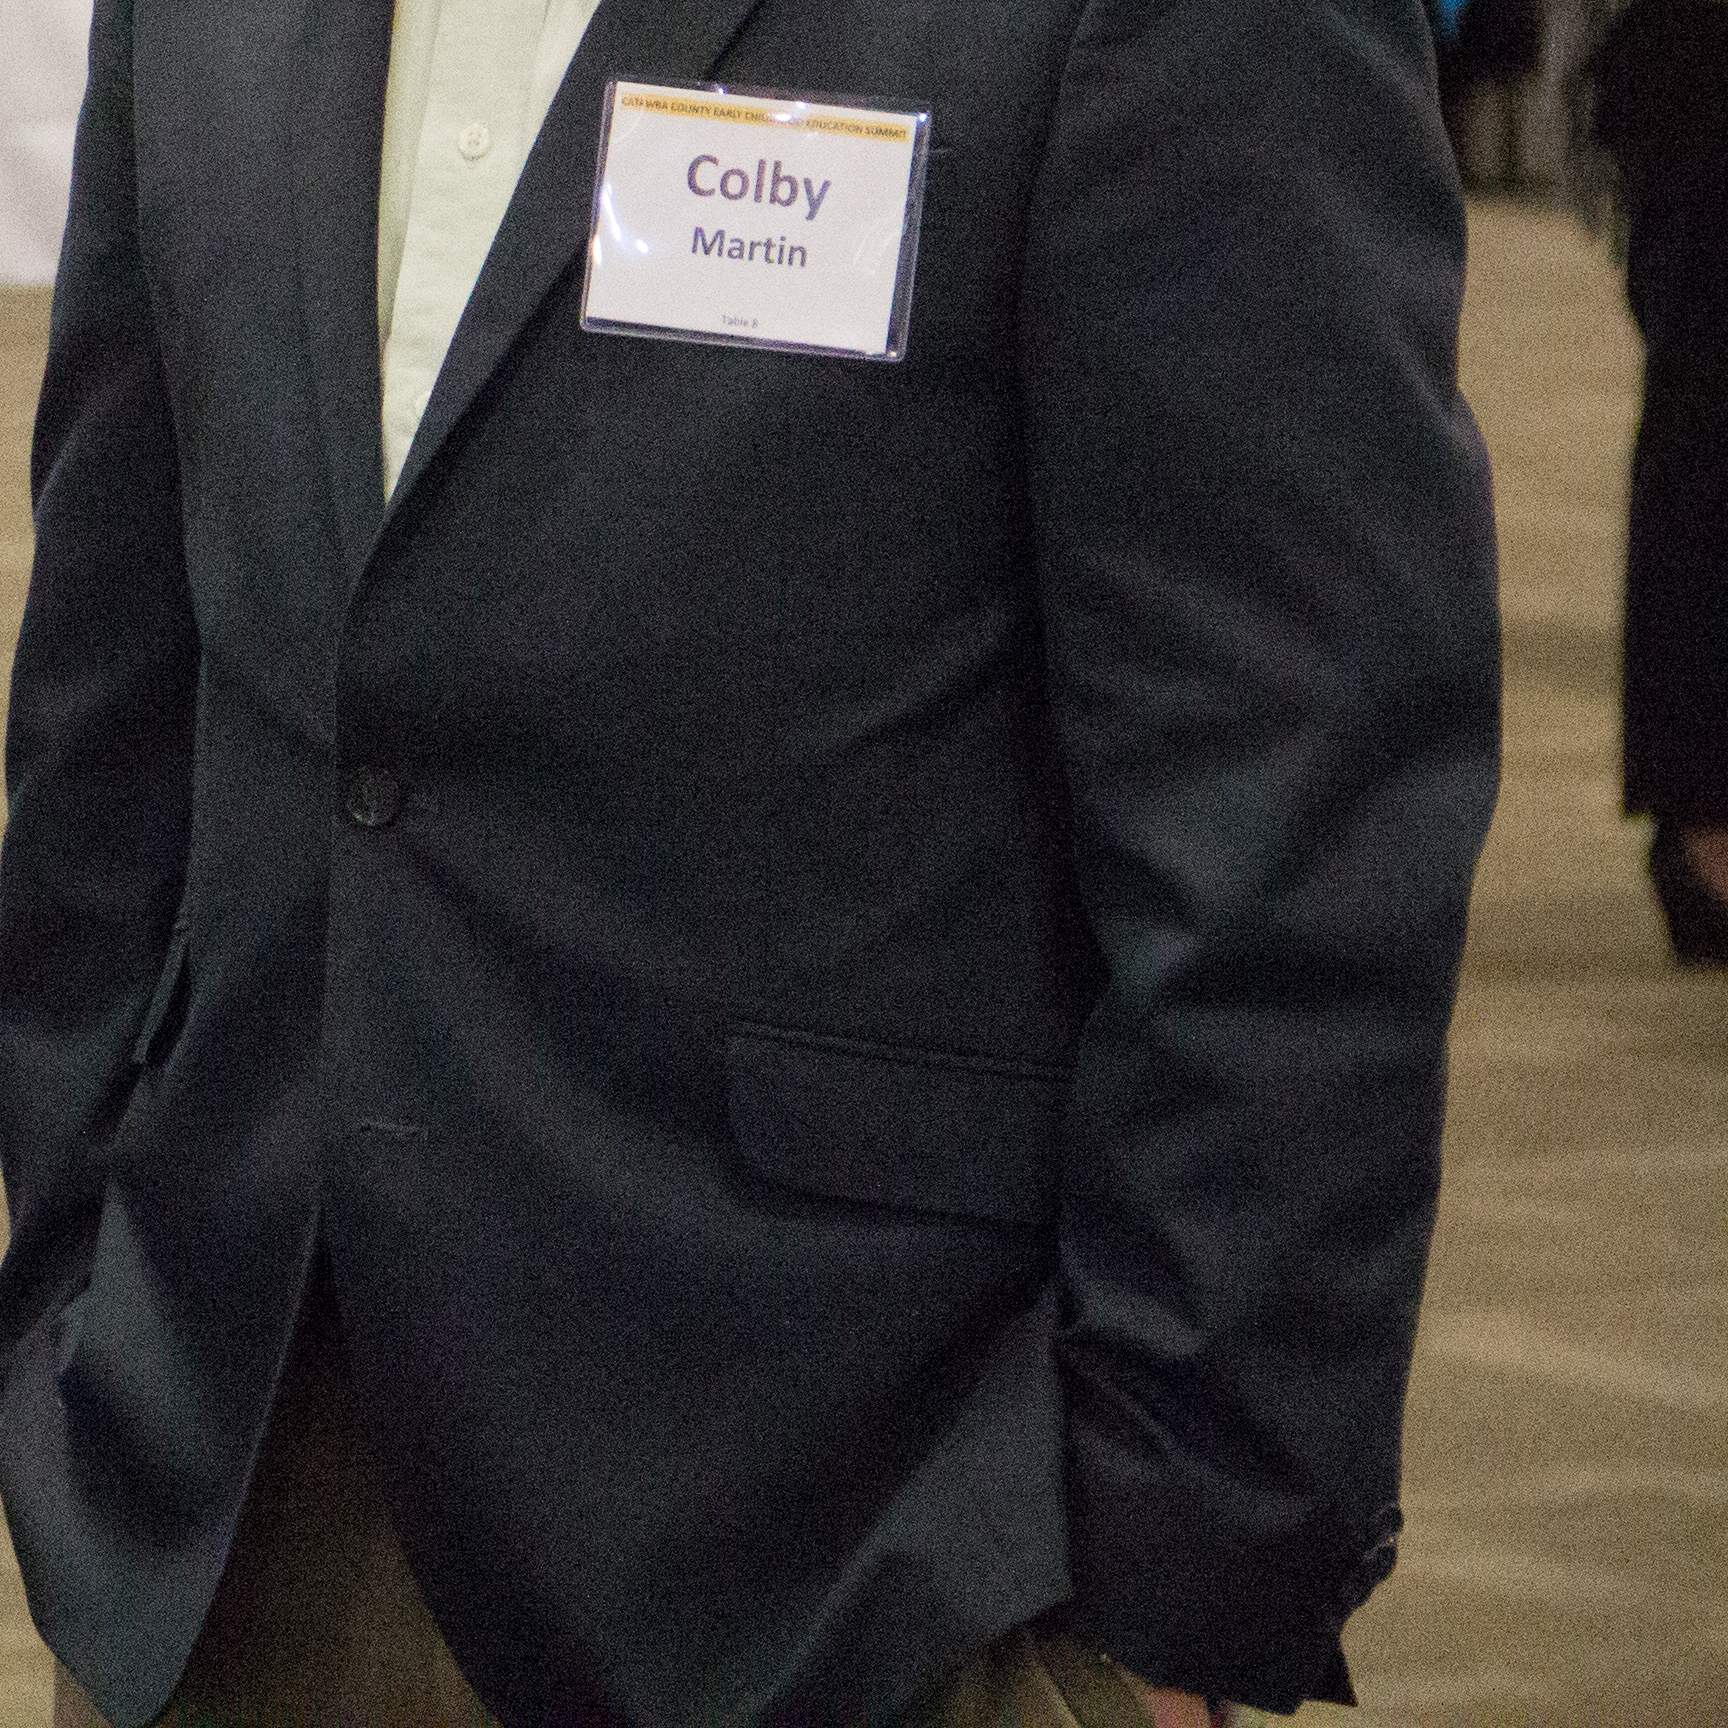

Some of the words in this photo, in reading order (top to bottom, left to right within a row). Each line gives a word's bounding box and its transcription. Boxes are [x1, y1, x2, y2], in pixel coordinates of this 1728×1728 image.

[620, 96, 668, 110] CATAWBA
[670, 102, 711, 115] COUNTY
[713, 107, 742, 119] EARLY
[806, 118, 863, 134] EDUCATION
[864, 125, 907, 139] SUMMIT
[688, 155, 829, 220] Colby
[692, 228, 806, 266] Martin
